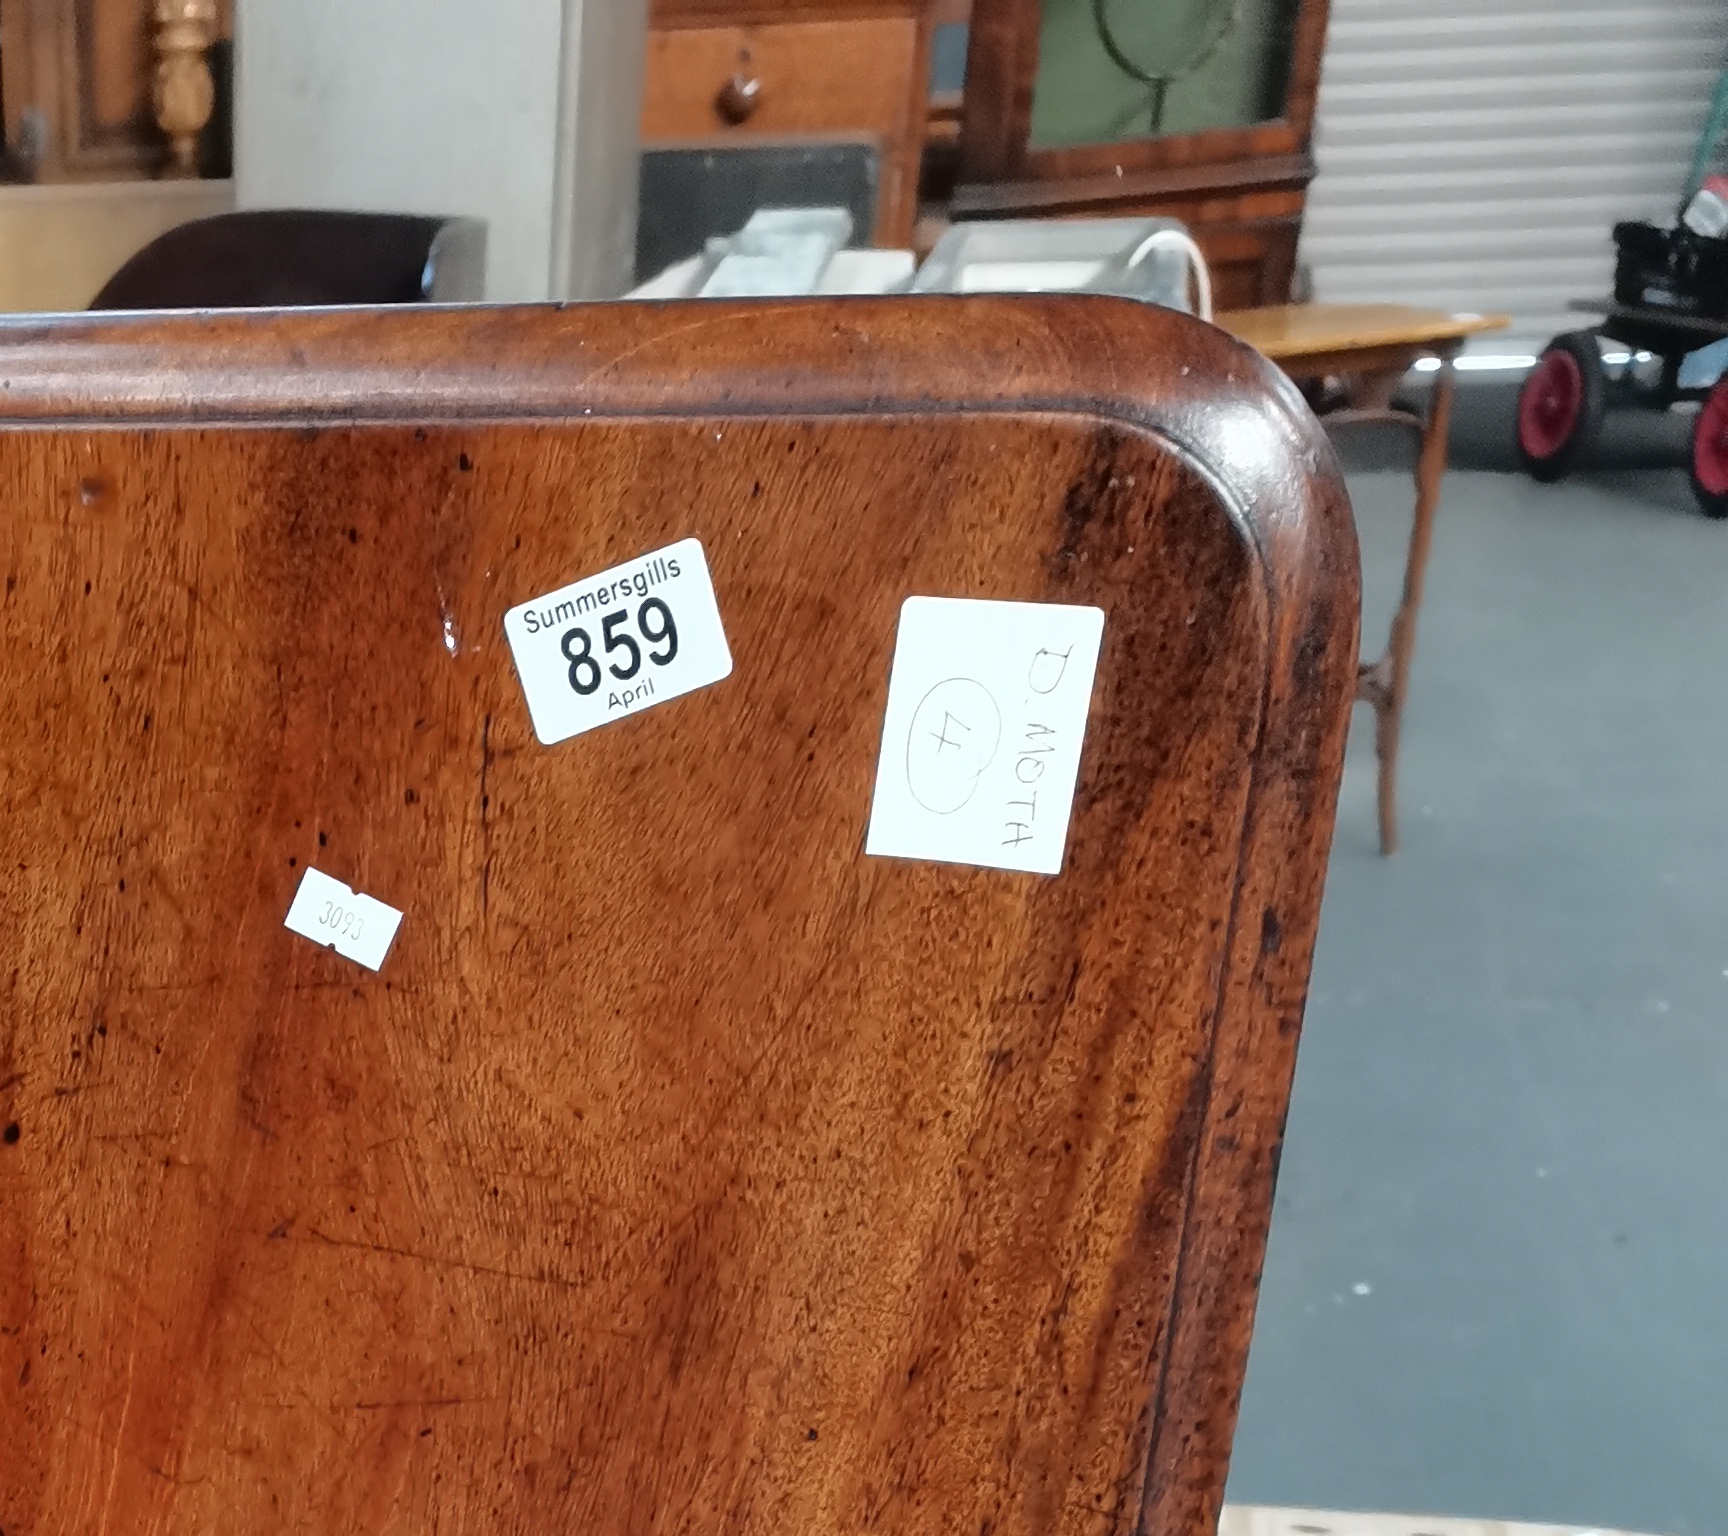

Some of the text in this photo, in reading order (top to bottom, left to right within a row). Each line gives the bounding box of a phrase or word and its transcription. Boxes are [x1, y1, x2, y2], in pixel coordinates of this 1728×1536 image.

[523, 557, 681, 633] Summersgills
[560, 597, 678, 695] 859
[608, 678, 655, 710] April
[929, 710, 971, 753] 4
[318, 900, 365, 941] 3093
